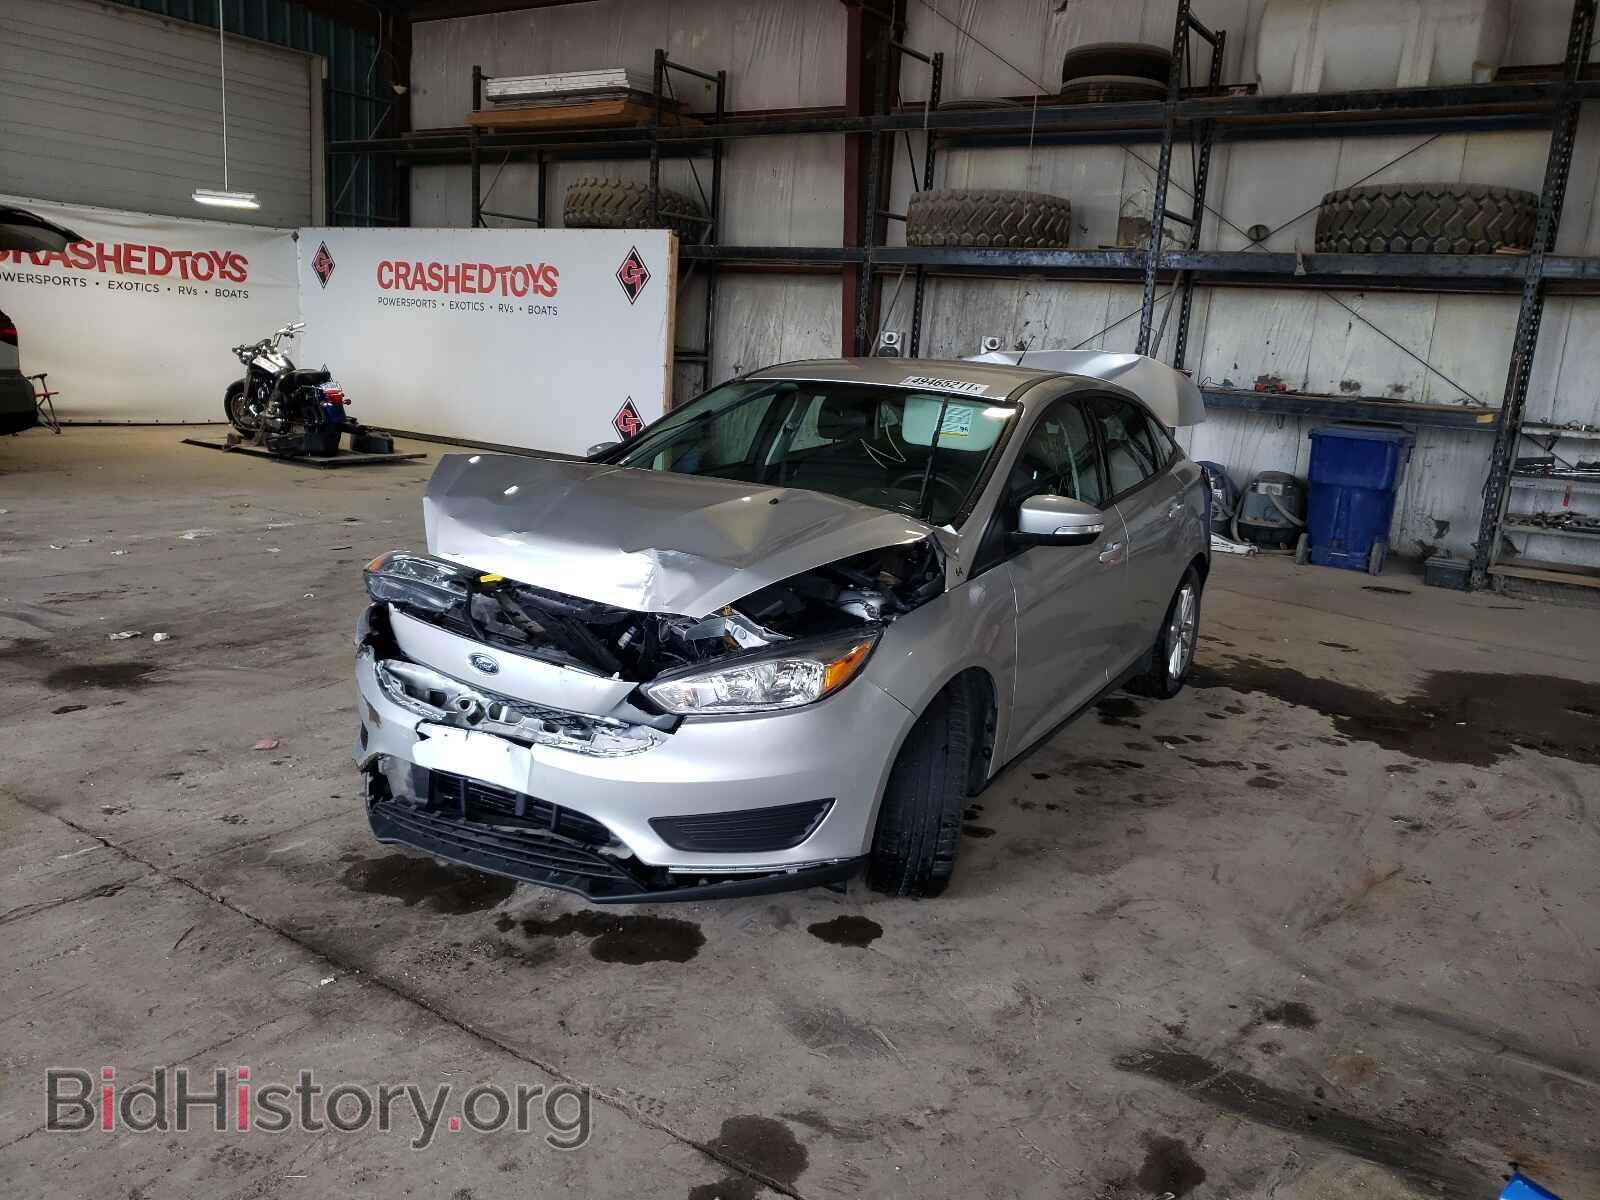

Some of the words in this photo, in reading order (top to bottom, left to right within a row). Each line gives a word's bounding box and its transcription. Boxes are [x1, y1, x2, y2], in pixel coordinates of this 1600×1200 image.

[377, 260, 560, 298] CRASHEDTOYS
[108, 280, 160, 293] EXOTICS
[178, 286, 198, 296] RVs
[215, 288, 249, 299] BOATS
[377, 296, 437, 309] POWERSPORTS
[449, 300, 485, 312] EXOTICS
[498, 303, 514, 313] RVs
[528, 305, 558, 316] BOATS
